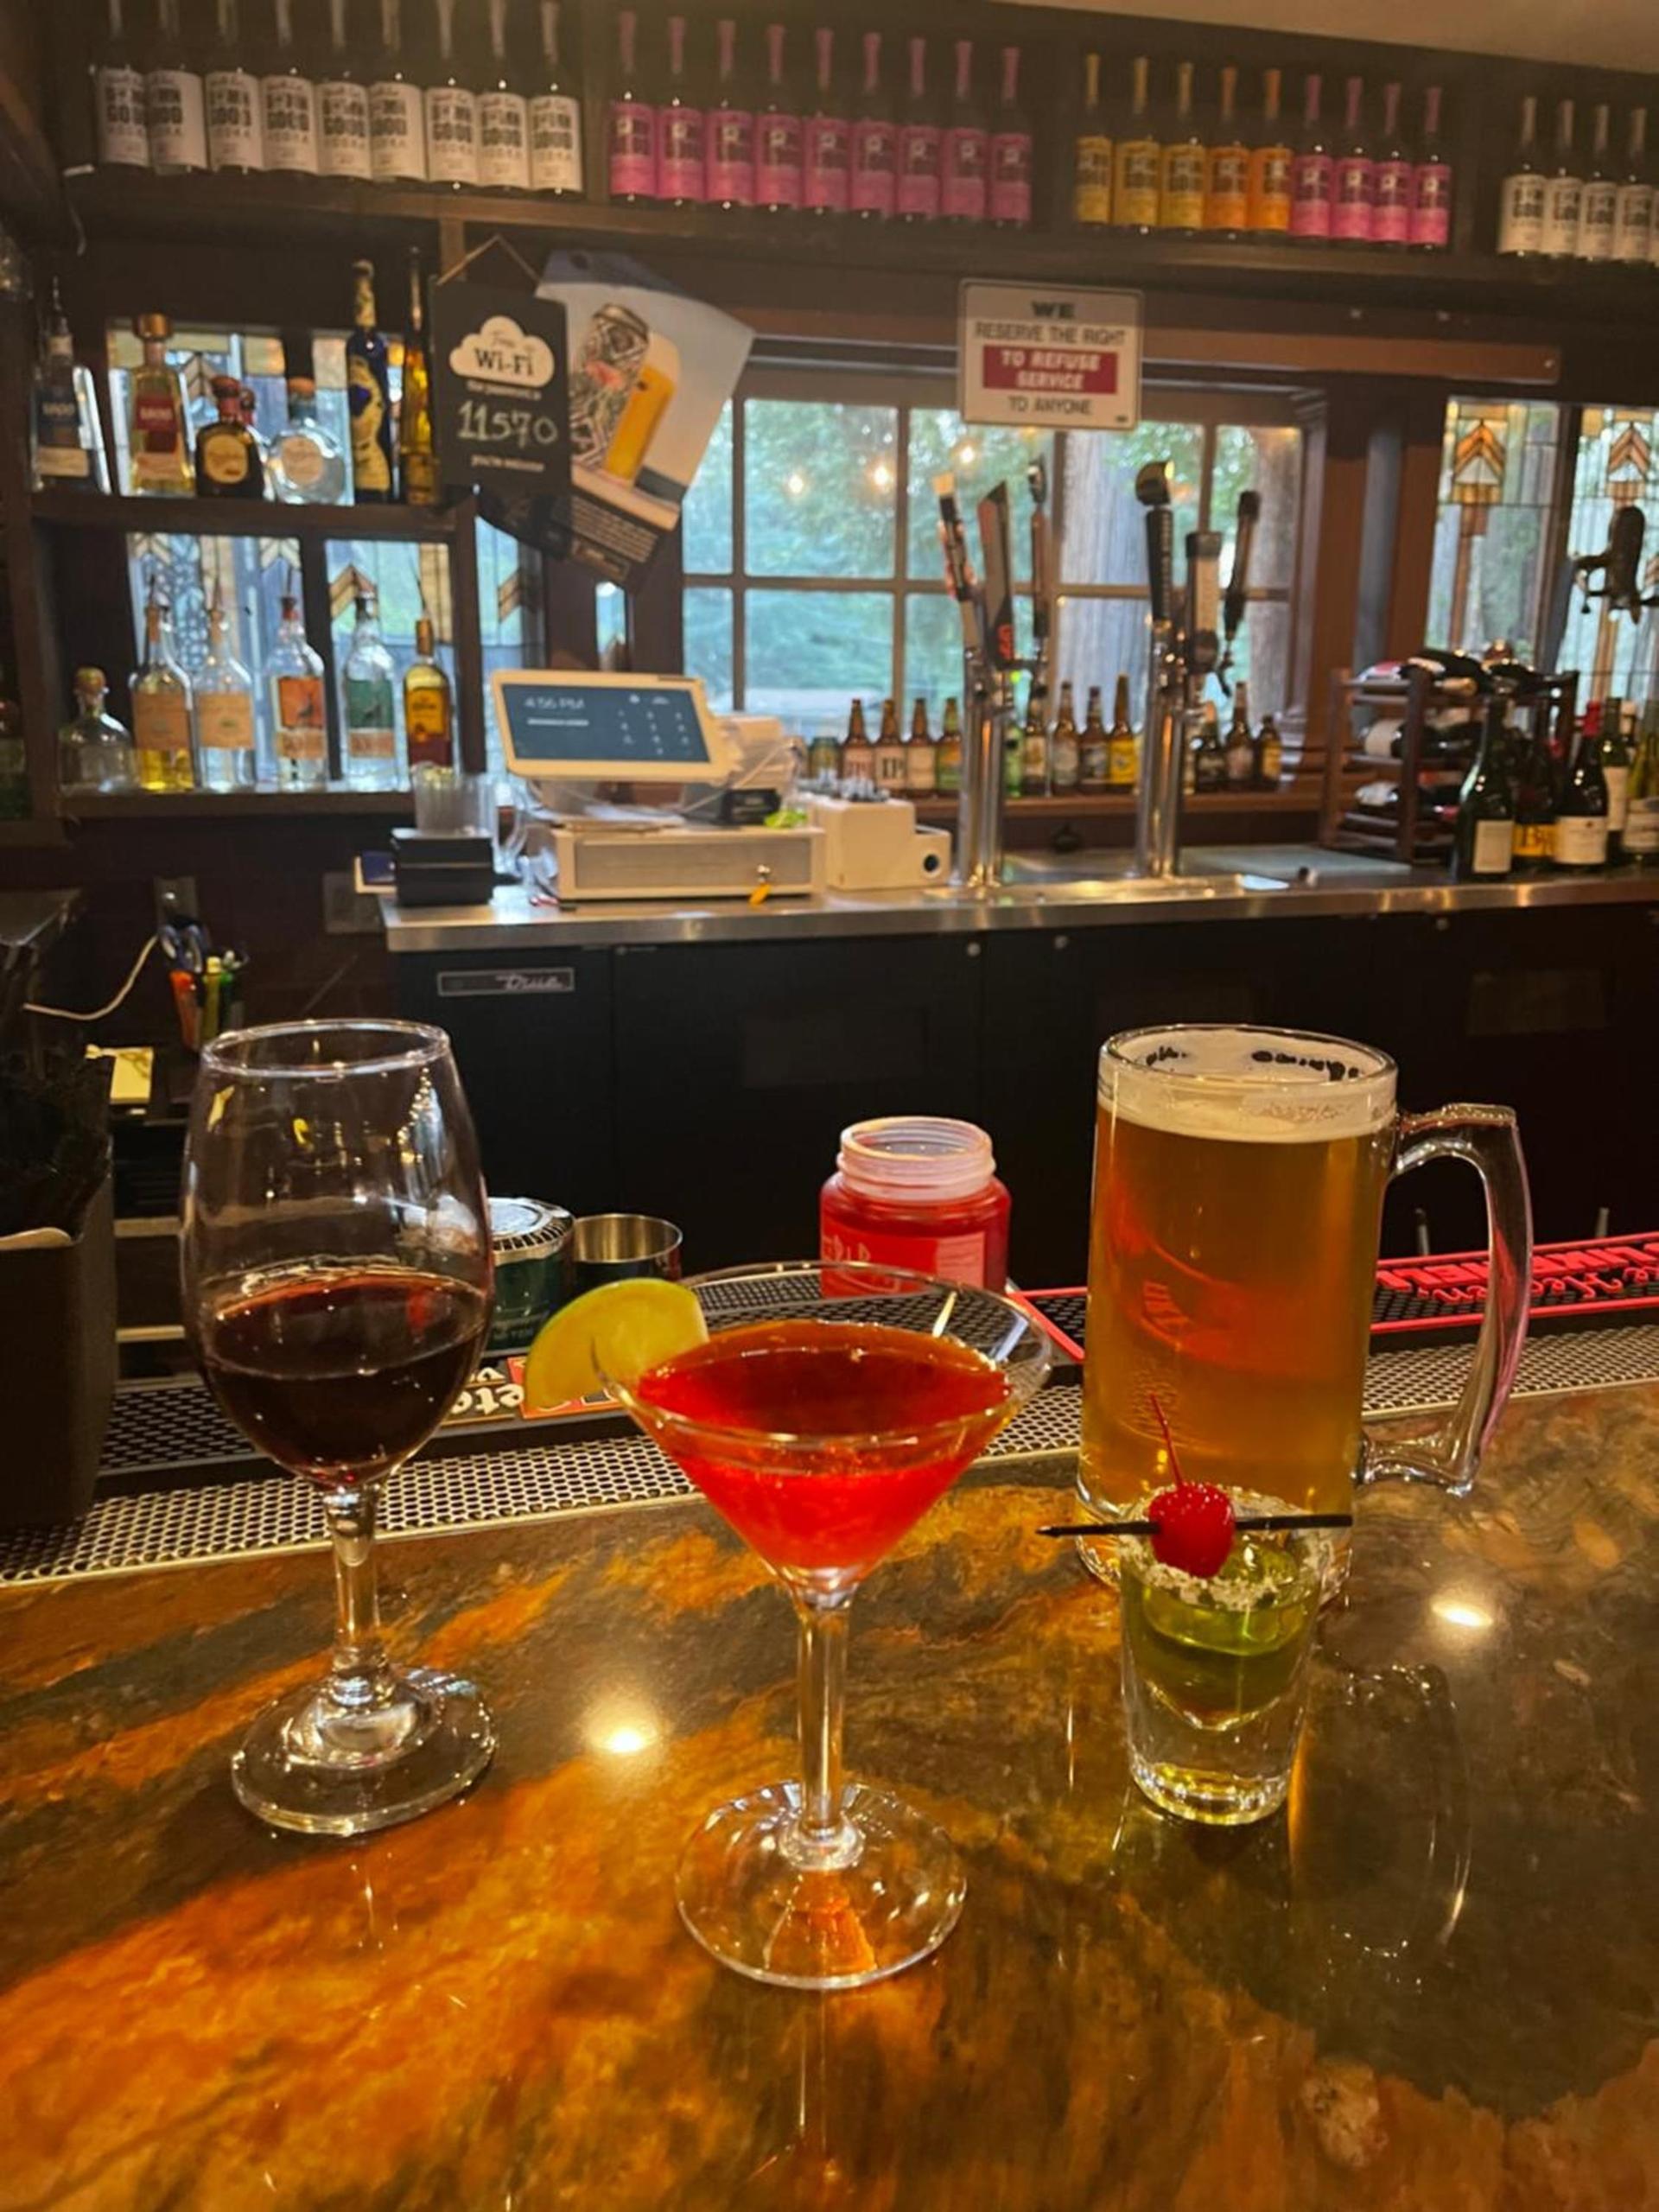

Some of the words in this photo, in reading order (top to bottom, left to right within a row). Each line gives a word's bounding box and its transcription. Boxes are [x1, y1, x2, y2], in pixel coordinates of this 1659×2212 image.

[1031, 302, 1075, 318] WE
[975, 321, 1043, 342] RESERVE
[1049, 326, 1078, 344] THE
[1083, 329, 1126, 345] RIGHT
[474, 348, 535, 377] Wi-Fi
[1001, 349, 1027, 367] TO
[1030, 352, 1102, 372] REFUSE
[1016, 370, 1084, 390] SERVICE
[1008, 396, 1029, 412] TO
[1035, 398, 1092, 416] ANYONE
[457, 399, 560, 449] 11570
